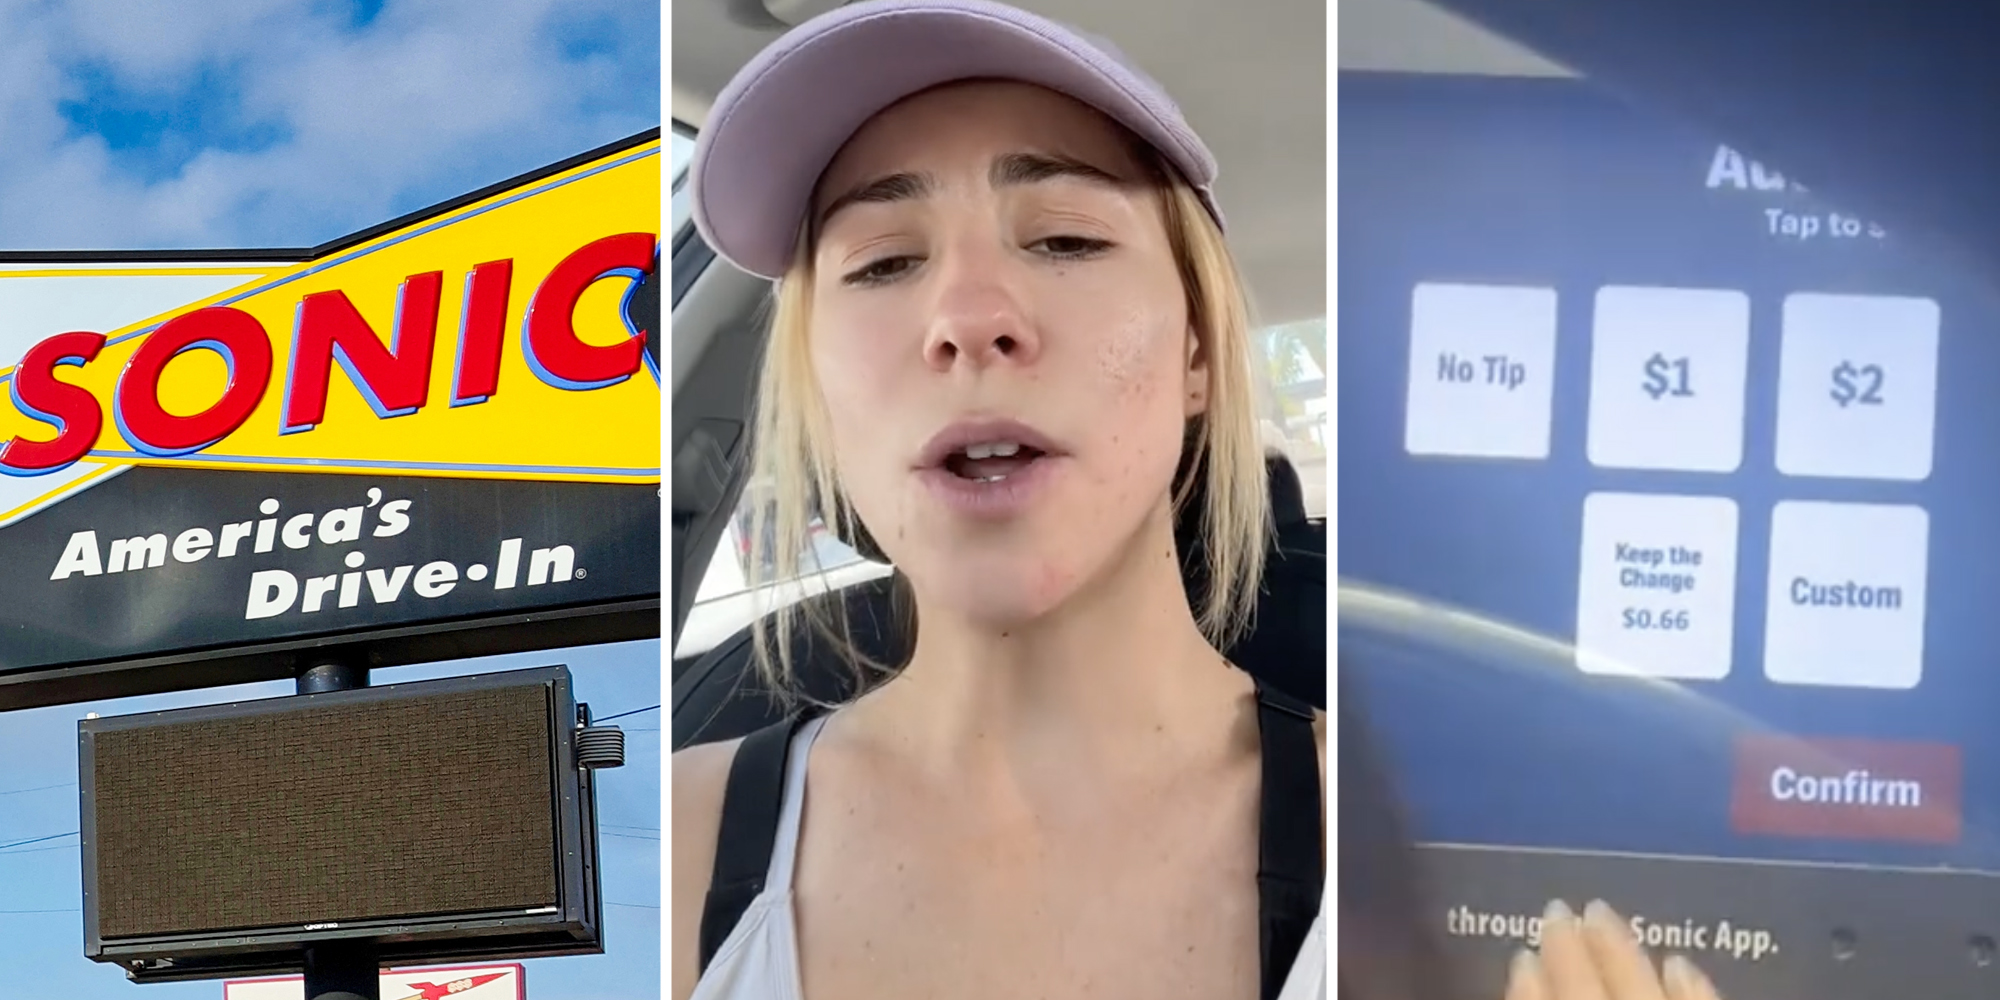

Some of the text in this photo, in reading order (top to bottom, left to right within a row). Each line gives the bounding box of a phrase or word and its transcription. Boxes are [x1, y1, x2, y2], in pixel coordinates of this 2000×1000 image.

[1765, 208, 1820, 240] Tap
[1829, 212, 1861, 238] to
[0, 231, 656, 478] SONIC
[1437, 353, 1526, 389] No Tip
[1642, 353, 1694, 399] $1
[1829, 361, 1884, 407] $2
[50, 487, 412, 581] America's
[1615, 543, 1702, 568] Keep the
[1620, 568, 1695, 593] Change
[1790, 577, 1902, 610] Custom
[1622, 607, 1690, 631] $0.66
[1770, 766, 1922, 807] Confirm
[1447, 906, 1780, 960] throug Sonic App.
